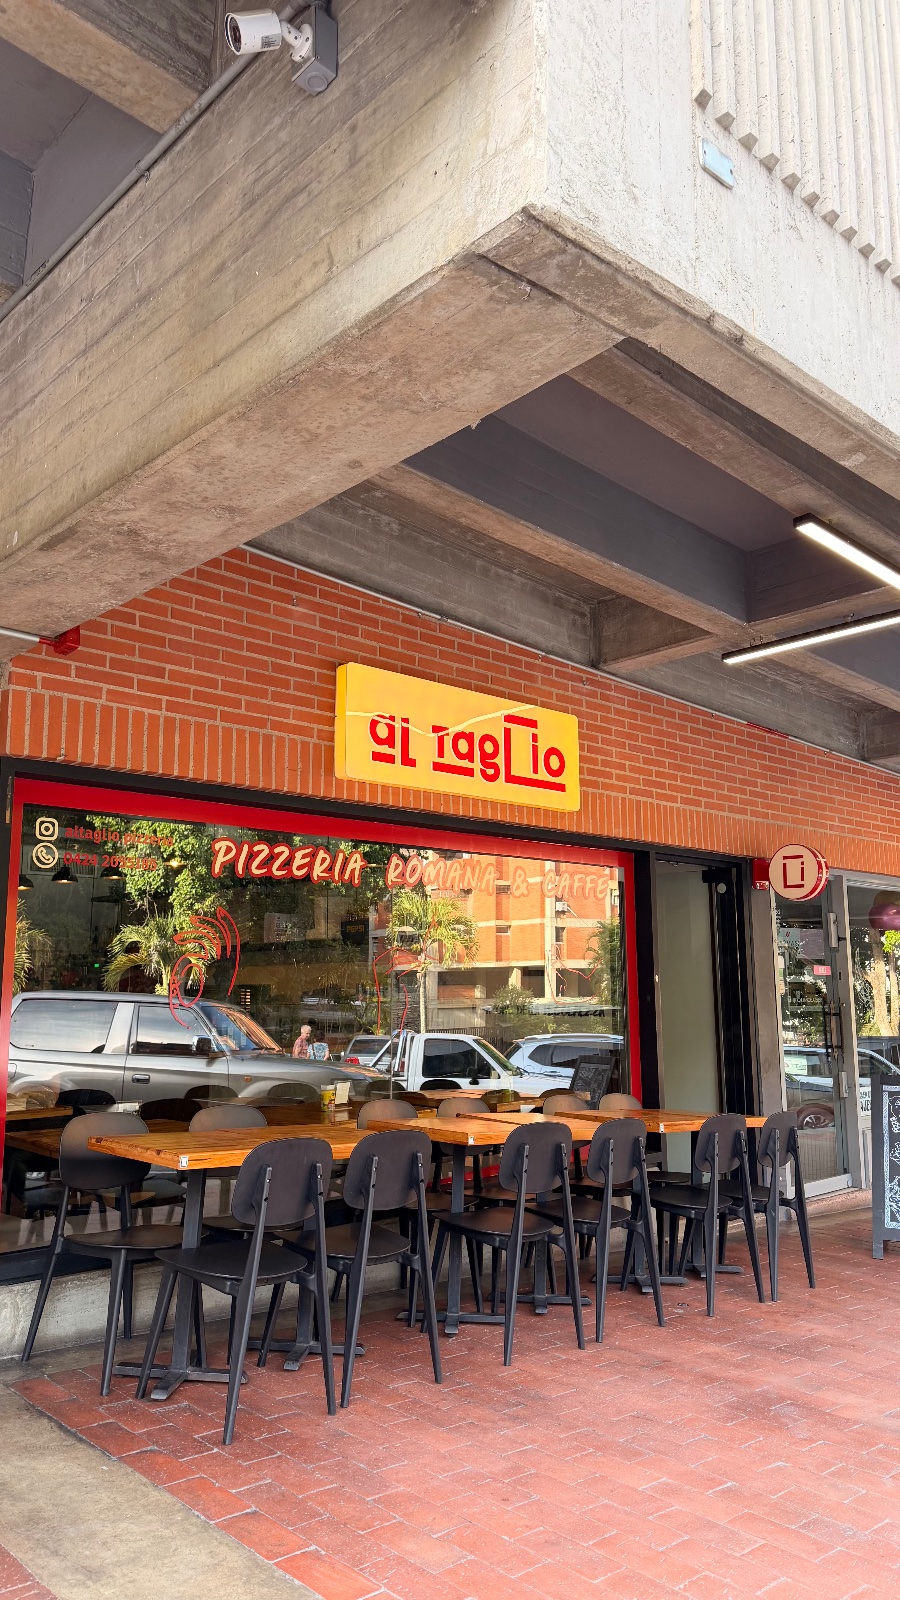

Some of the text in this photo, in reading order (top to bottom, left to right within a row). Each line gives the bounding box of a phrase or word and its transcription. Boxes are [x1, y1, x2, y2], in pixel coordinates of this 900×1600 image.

[63, 851, 99, 867] 0424
[212, 838, 367, 887] PIZZERIA
[386, 854, 498, 895] ROMANA
[511, 866, 530, 898] &
